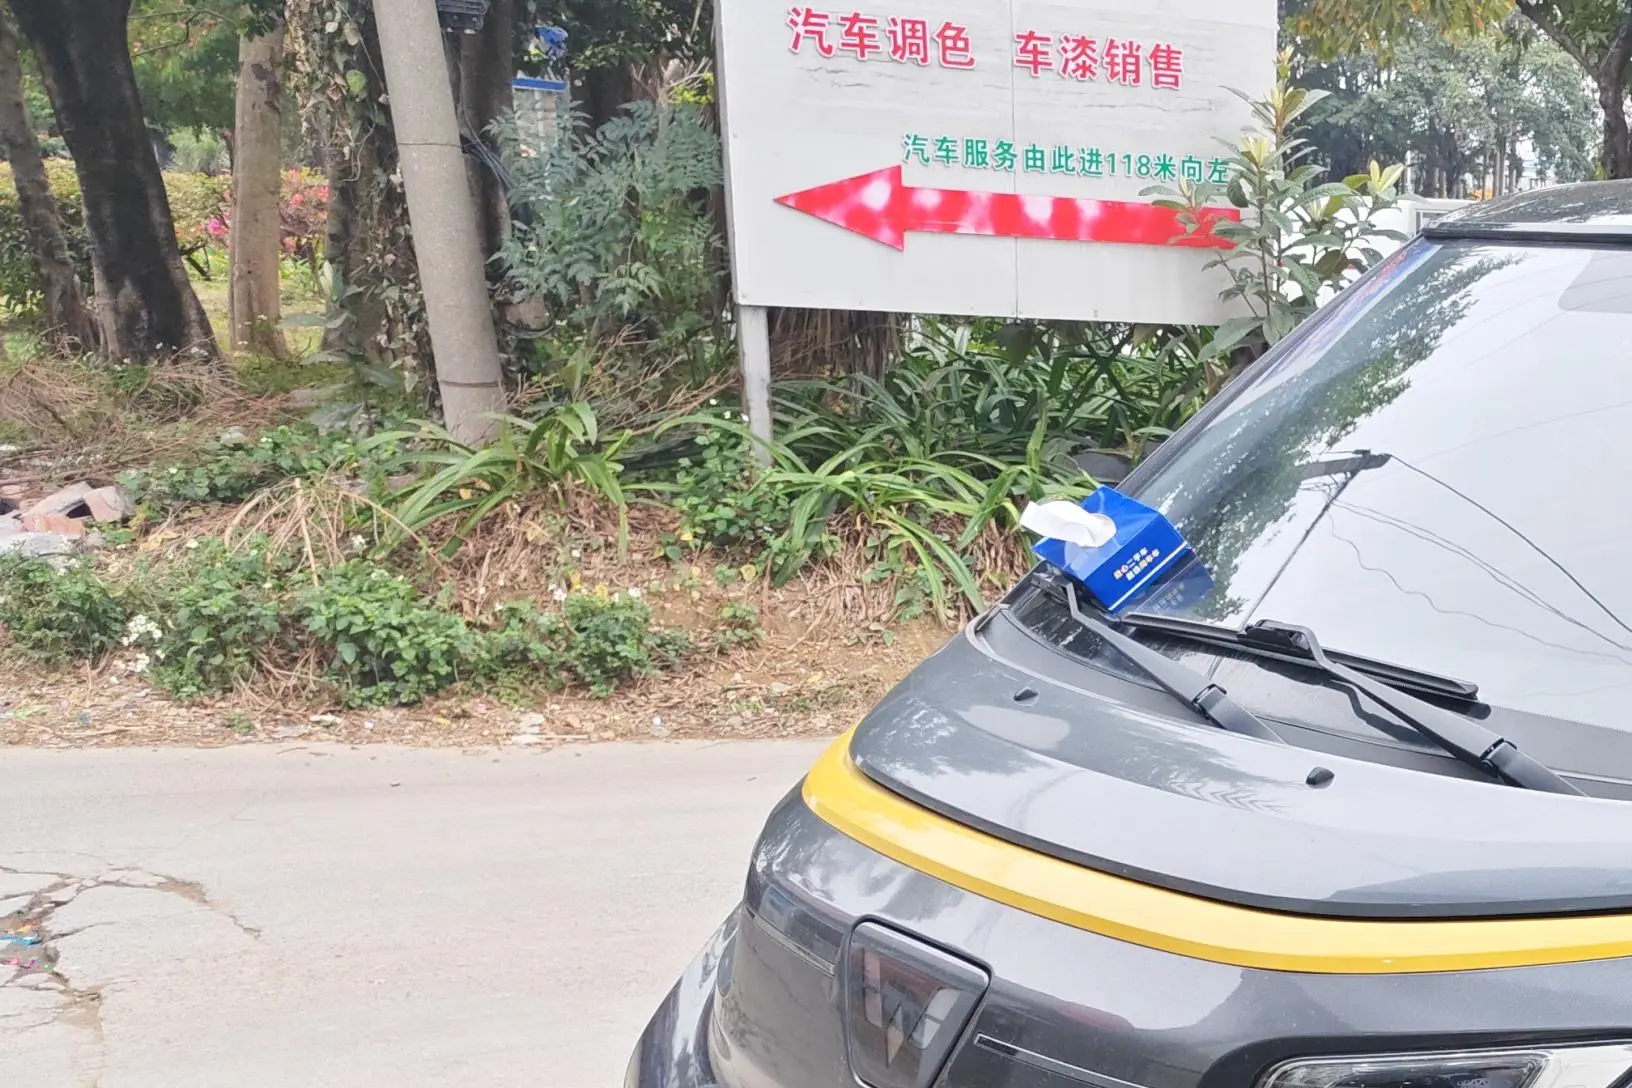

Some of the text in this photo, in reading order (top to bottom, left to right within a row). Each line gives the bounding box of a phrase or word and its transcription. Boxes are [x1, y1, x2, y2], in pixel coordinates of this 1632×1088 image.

[788, 6, 1183, 88] 汽车调色 车漆销售
[903, 133, 1230, 184] 汽车服务由此进118米向左
